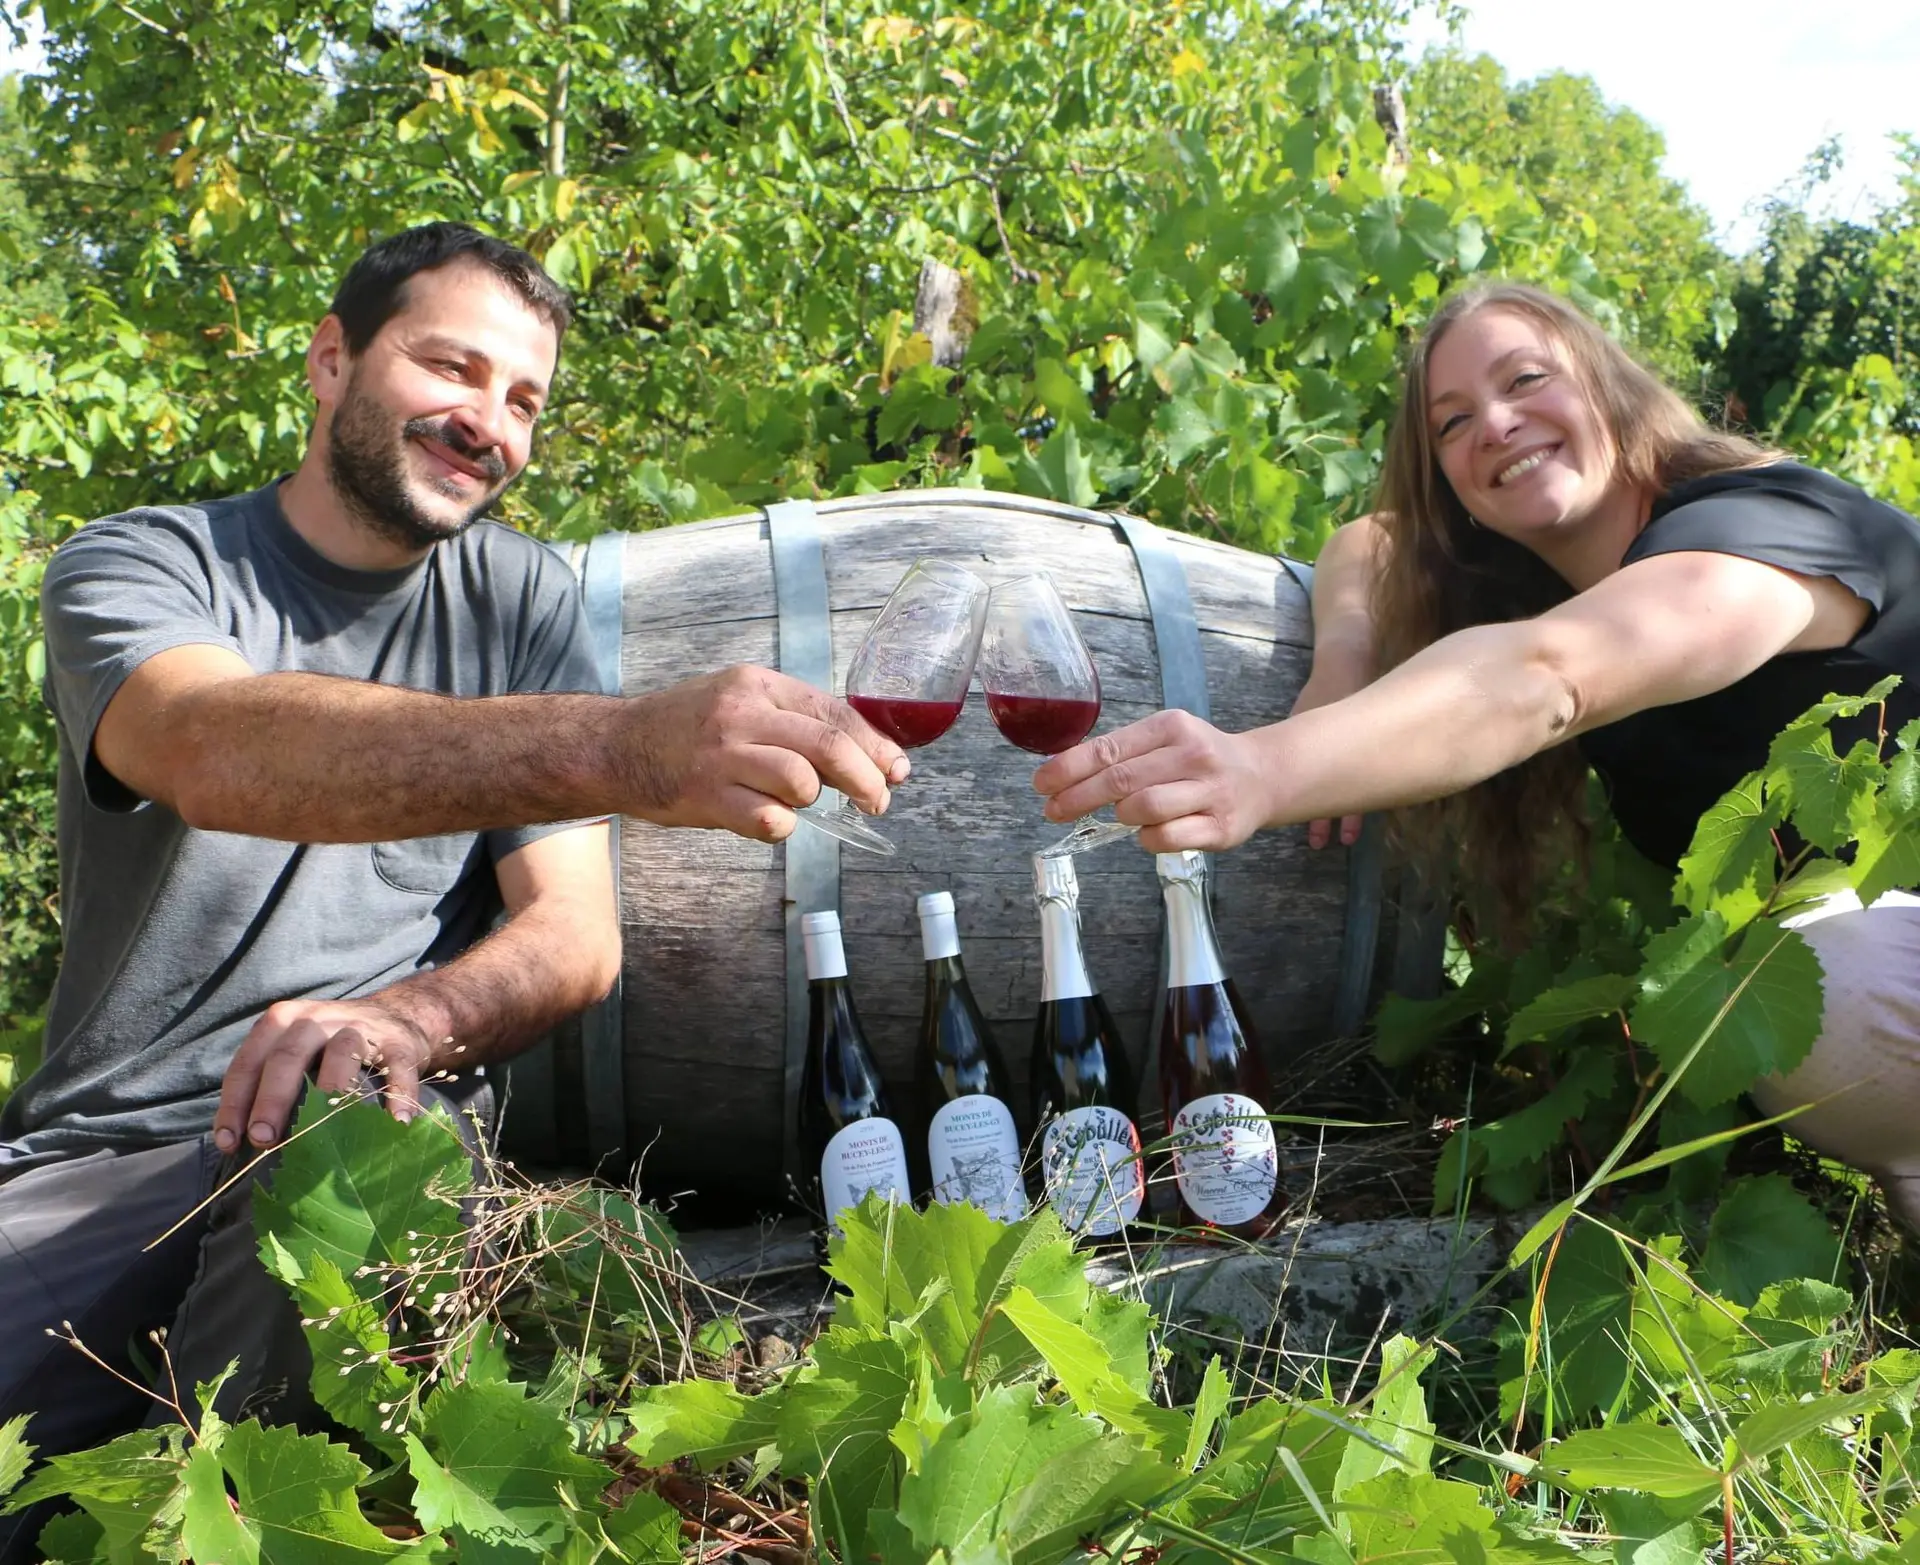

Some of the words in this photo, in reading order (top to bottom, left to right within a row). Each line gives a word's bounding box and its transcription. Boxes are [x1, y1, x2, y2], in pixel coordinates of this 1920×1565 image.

[951, 1112, 981, 1123] MONTS
[982, 1109, 992, 1118] DE
[944, 1117, 1000, 1133] BUCEY-LES-GY
[848, 1138, 878, 1149] MONTS
[879, 1135, 888, 1144] DE
[841, 1142, 895, 1161] BUCEY-LES-GY
